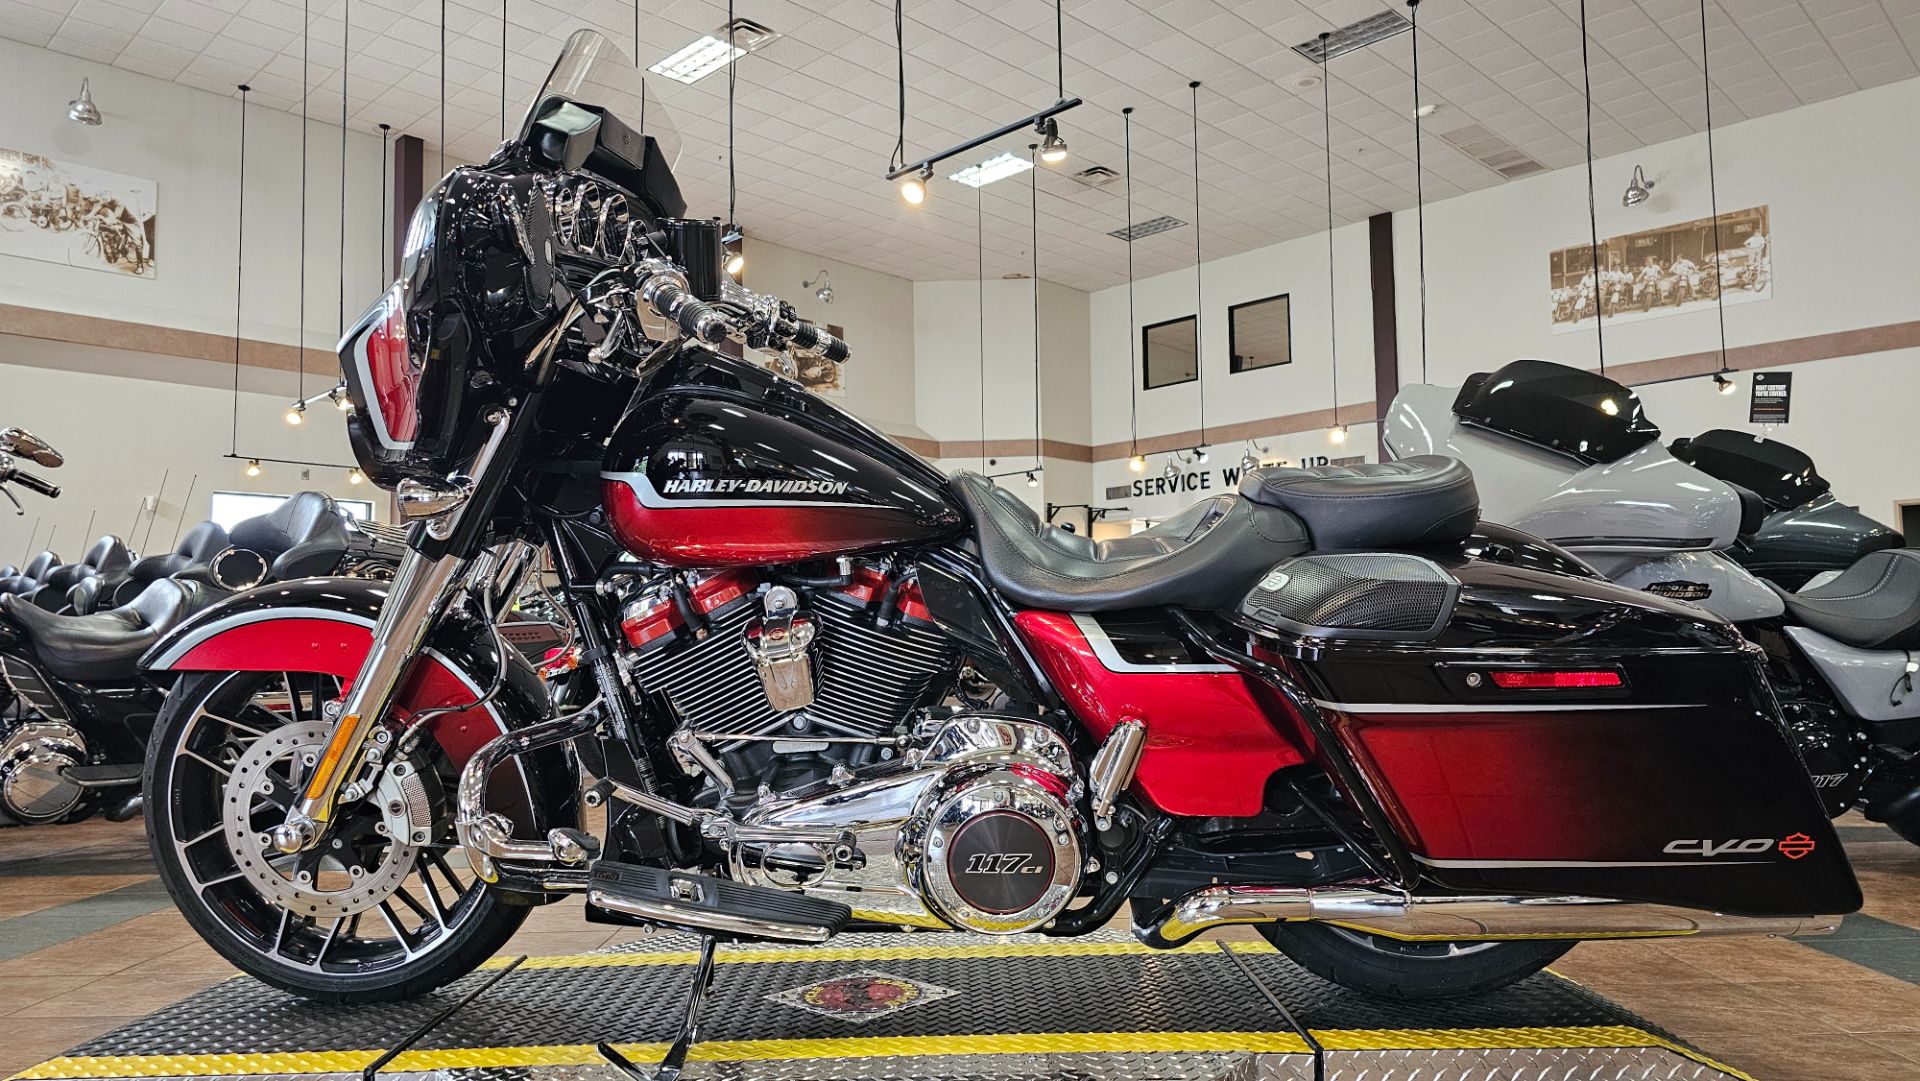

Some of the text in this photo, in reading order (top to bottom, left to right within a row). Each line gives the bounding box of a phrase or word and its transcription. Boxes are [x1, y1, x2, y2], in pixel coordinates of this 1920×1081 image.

[663, 478, 850, 495] HARLEY-DAVIDSON
[1132, 471, 1211, 497] SERVICE
[1662, 838, 1775, 857] CVO
[965, 853, 1033, 874] 117
